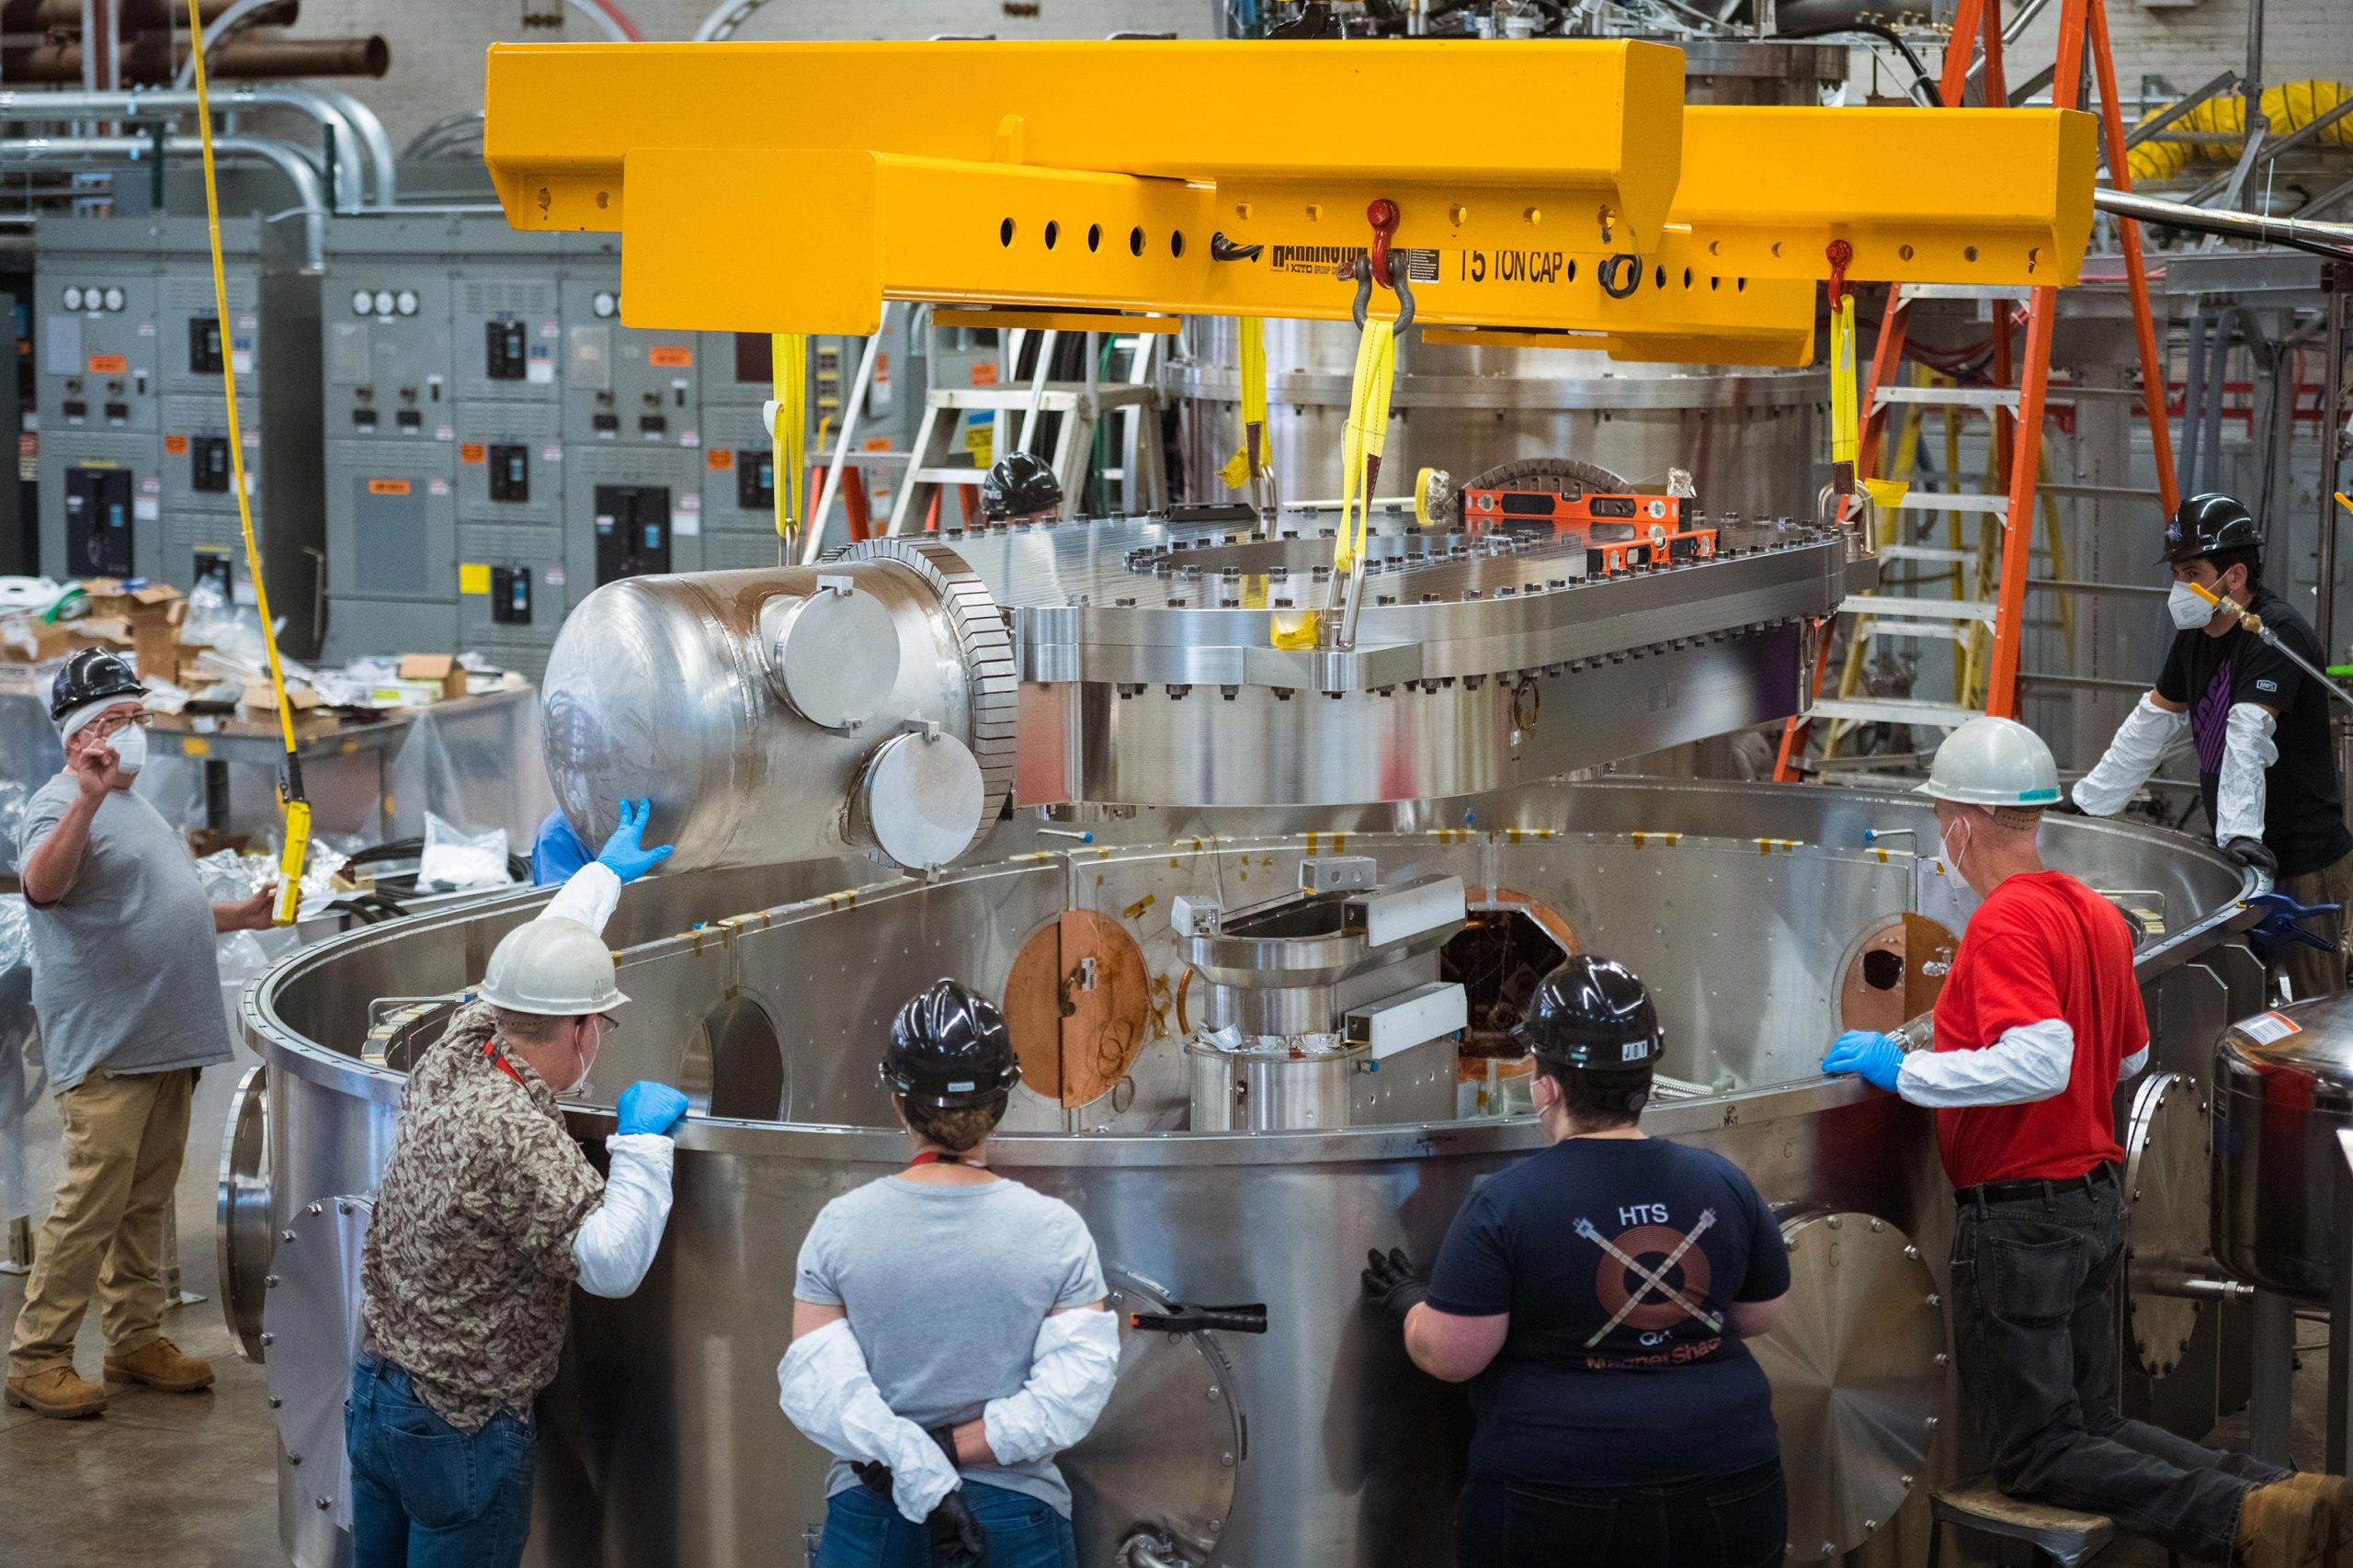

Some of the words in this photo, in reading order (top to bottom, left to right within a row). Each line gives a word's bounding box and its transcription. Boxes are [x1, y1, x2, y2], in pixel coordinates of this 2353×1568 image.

[1290, 263, 1313, 274] KITO
[1529, 251, 1563, 284] CAP
[1624, 1042, 1645, 1059] JOY
[1619, 1203, 1669, 1226] HTS
